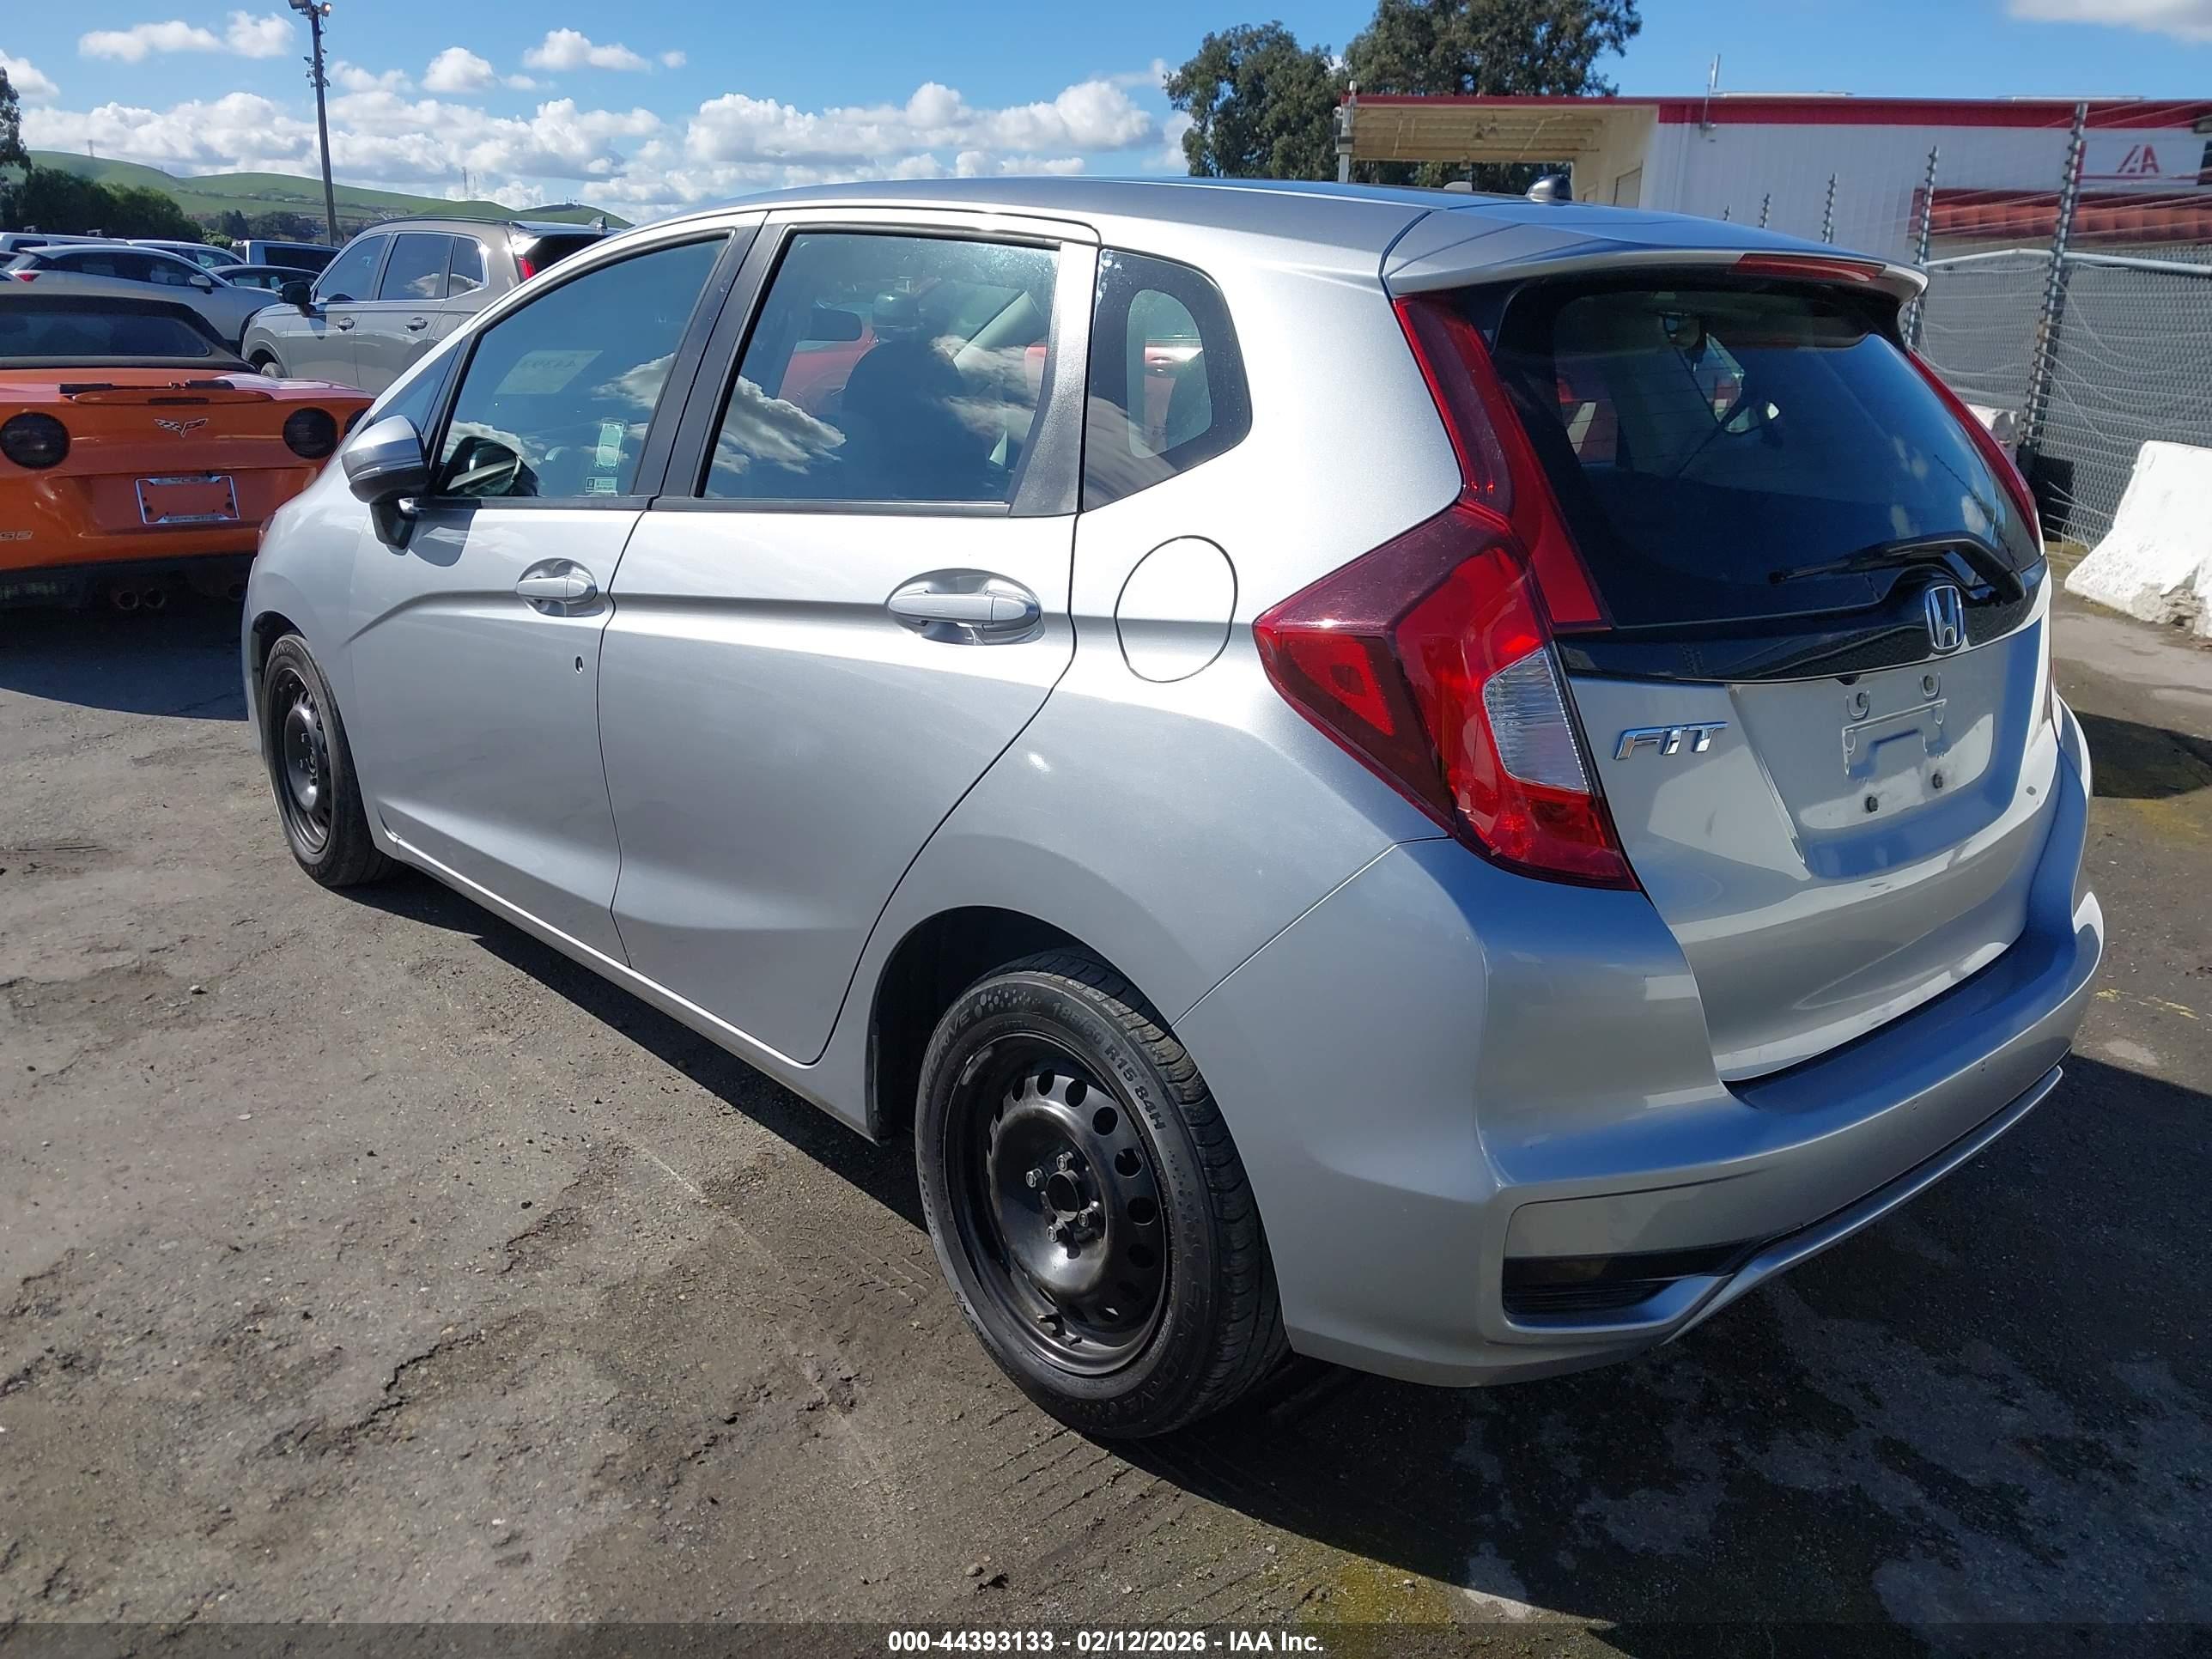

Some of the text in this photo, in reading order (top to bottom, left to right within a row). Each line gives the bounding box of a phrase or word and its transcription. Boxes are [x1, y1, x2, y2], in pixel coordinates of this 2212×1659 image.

[1613, 720, 1729, 760] FIT
[1104, 1045, 1139, 1083] R15
[1134, 1085, 1167, 1130] 84H
